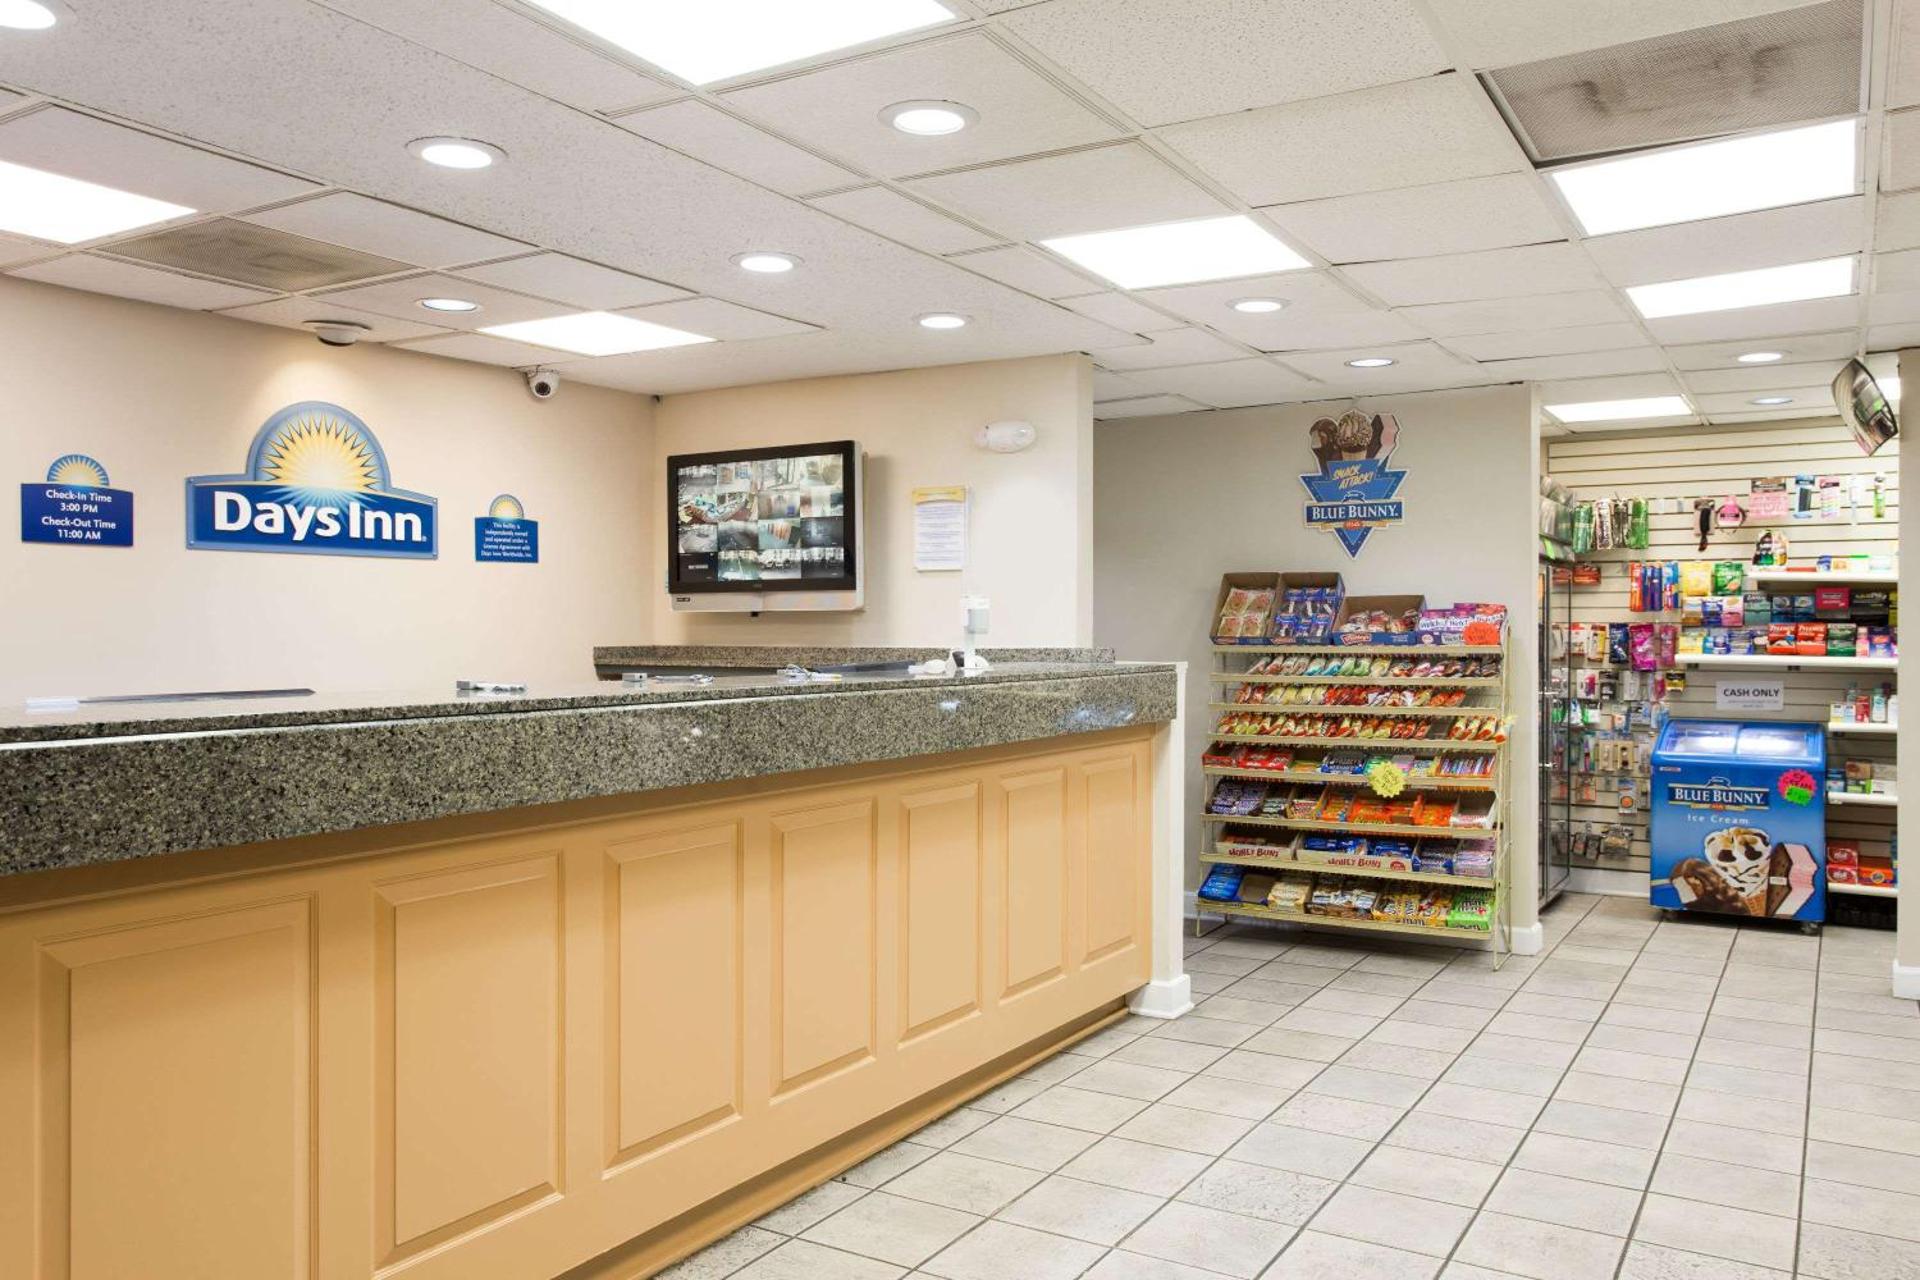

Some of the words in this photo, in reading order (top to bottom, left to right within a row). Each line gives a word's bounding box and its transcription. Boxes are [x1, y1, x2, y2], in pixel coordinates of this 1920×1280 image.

[45, 489, 87, 500] Check-In
[89, 492, 112, 502] Time
[60, 502, 81, 512] 3:00
[83, 504, 98, 513] PM
[1312, 506, 1346, 520] BLUE
[1349, 504, 1397, 518] BUNNY
[41, 516, 92, 528] Check-Out
[94, 519, 116, 529] Time
[214, 491, 342, 541] Days
[349, 502, 423, 542] Inn
[58, 529, 83, 539] 11:00
[85, 531, 101, 540] AM
[1723, 688, 1750, 696] CASH
[1752, 688, 1780, 696] ONLY
[1674, 788, 1710, 801] BLUE
[1713, 790, 1764, 804] BUNNY
[1687, 814, 1705, 822] Ice
[1710, 815, 1749, 824] Cream
